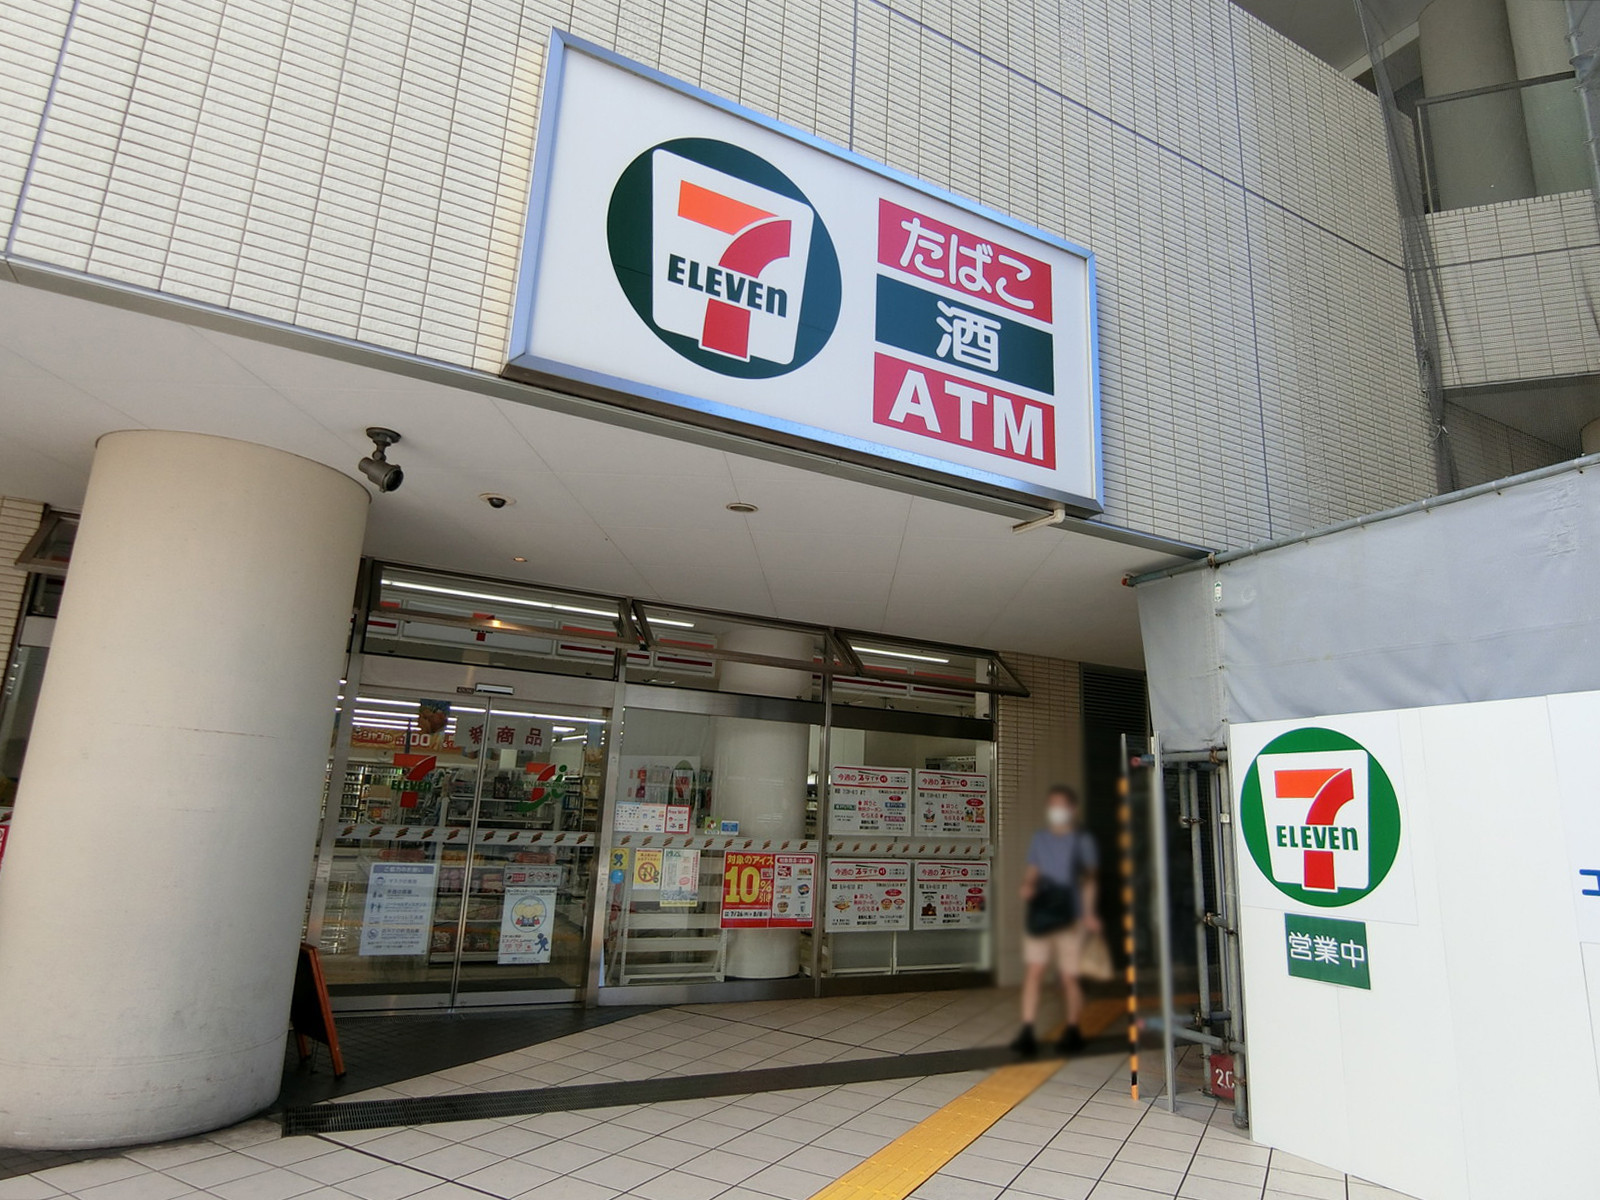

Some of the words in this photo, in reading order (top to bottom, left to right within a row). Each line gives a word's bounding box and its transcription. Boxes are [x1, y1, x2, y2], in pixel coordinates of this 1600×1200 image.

[900, 217, 1034, 310] たばこ
[935, 301, 1002, 372] 酒
[888, 369, 1044, 461] ATM
[1289, 931, 1365, 968] 営業中
